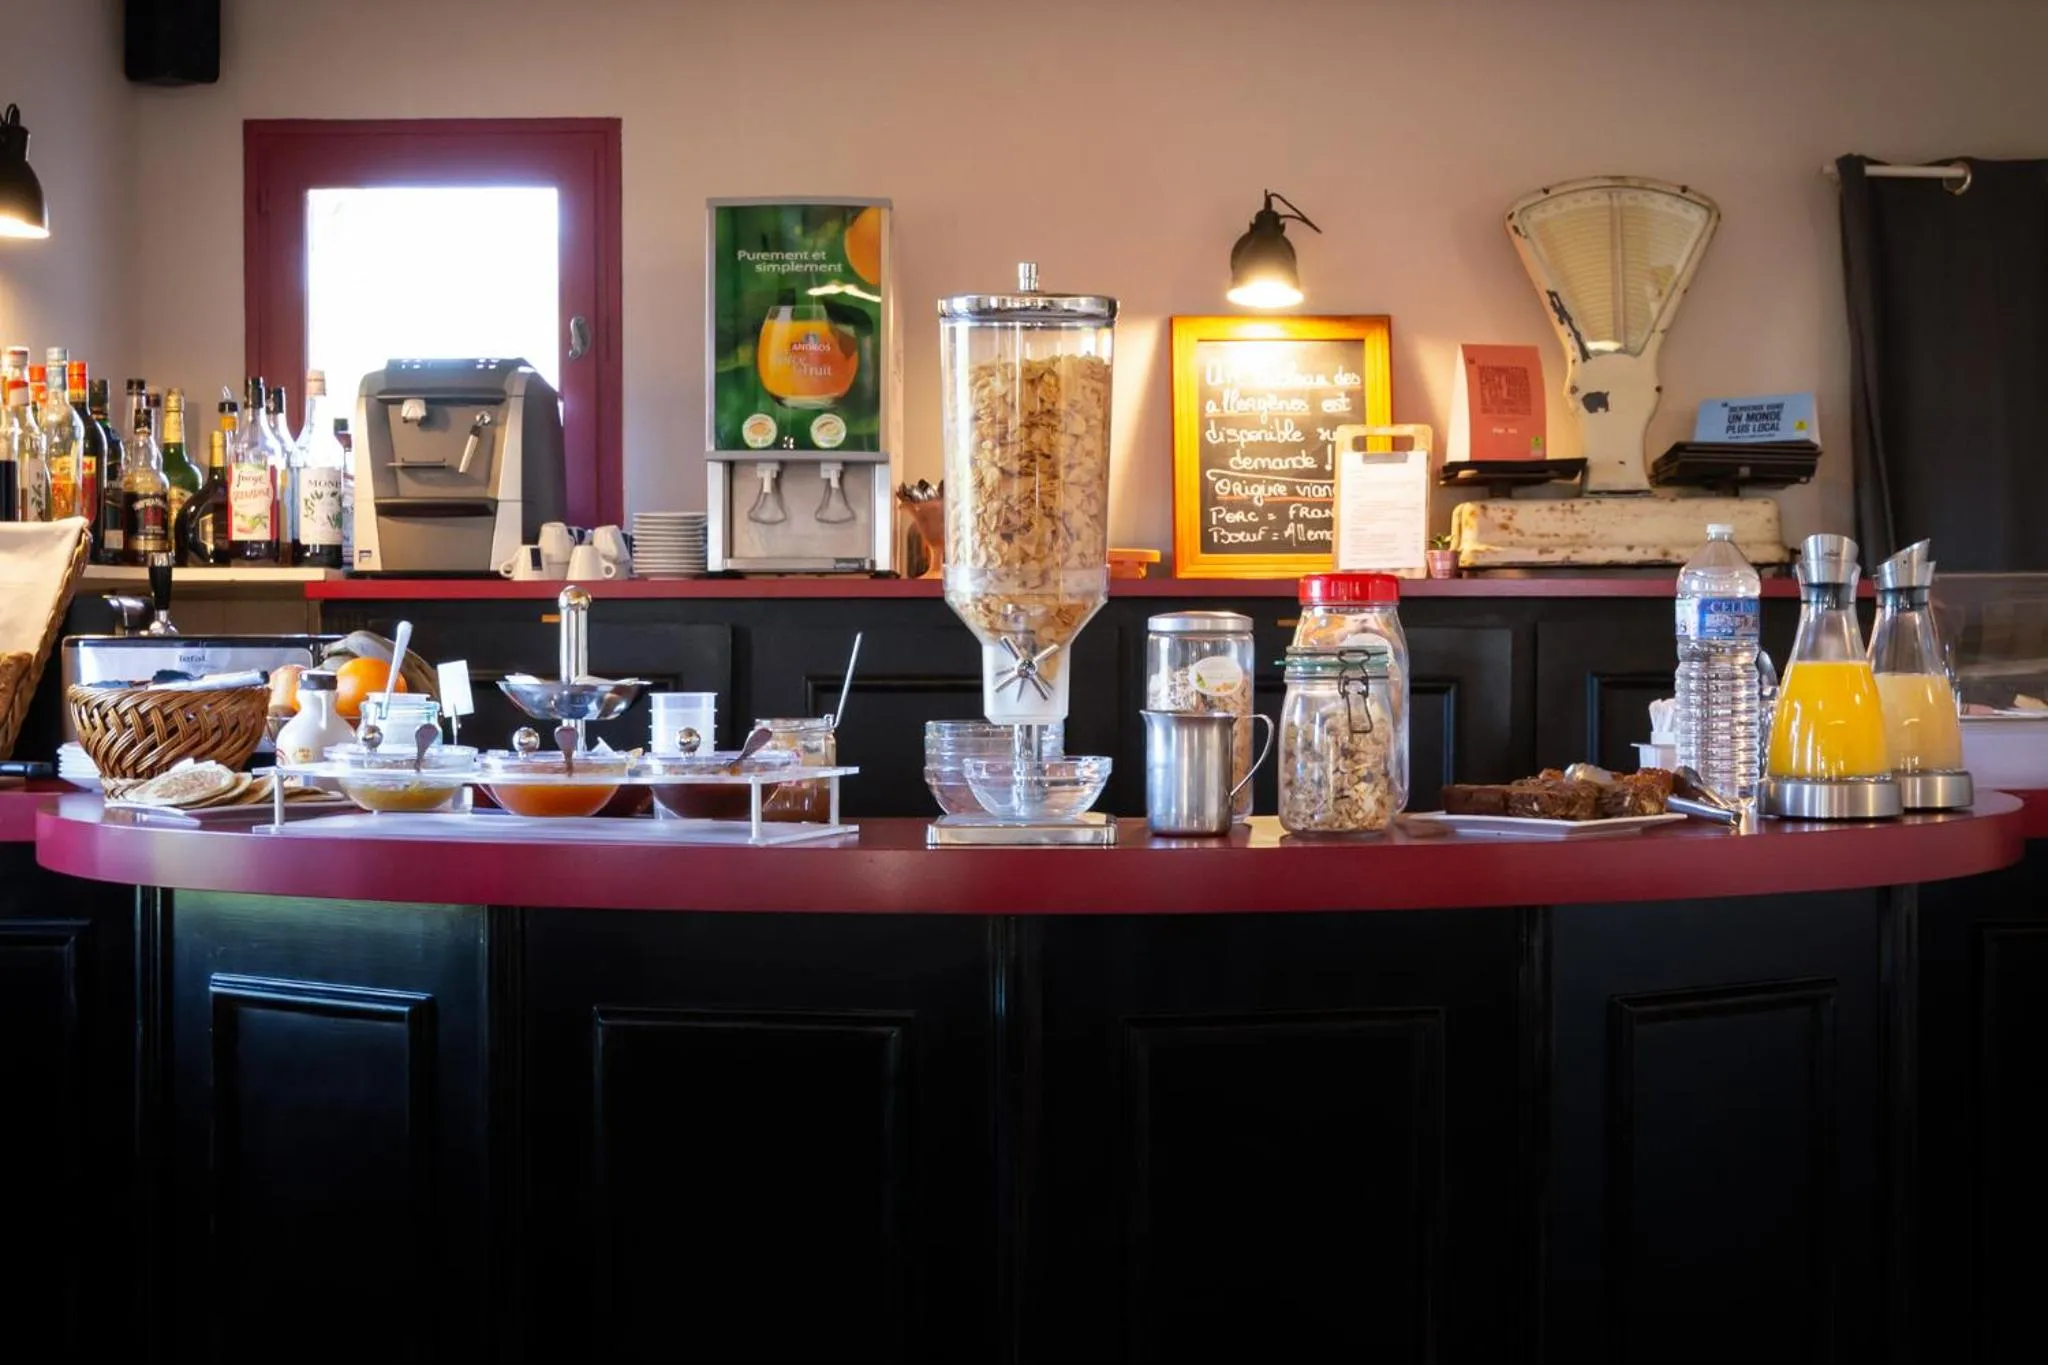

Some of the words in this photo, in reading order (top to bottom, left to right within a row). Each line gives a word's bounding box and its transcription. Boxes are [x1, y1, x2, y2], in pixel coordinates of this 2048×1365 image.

[737, 250, 809, 261] Purement
[812, 251, 826, 261] et
[755, 261, 843, 275] simplement
[1333, 365, 1361, 386] des
[1321, 391, 1352, 413] est
[1727, 413, 1743, 424] UN
[1745, 410, 1782, 423] MONDE
[1205, 418, 1305, 449] disponible
[1726, 422, 1750, 434] PLUS
[1752, 420, 1780, 433] LOCAL
[1229, 448, 1318, 470] demande
